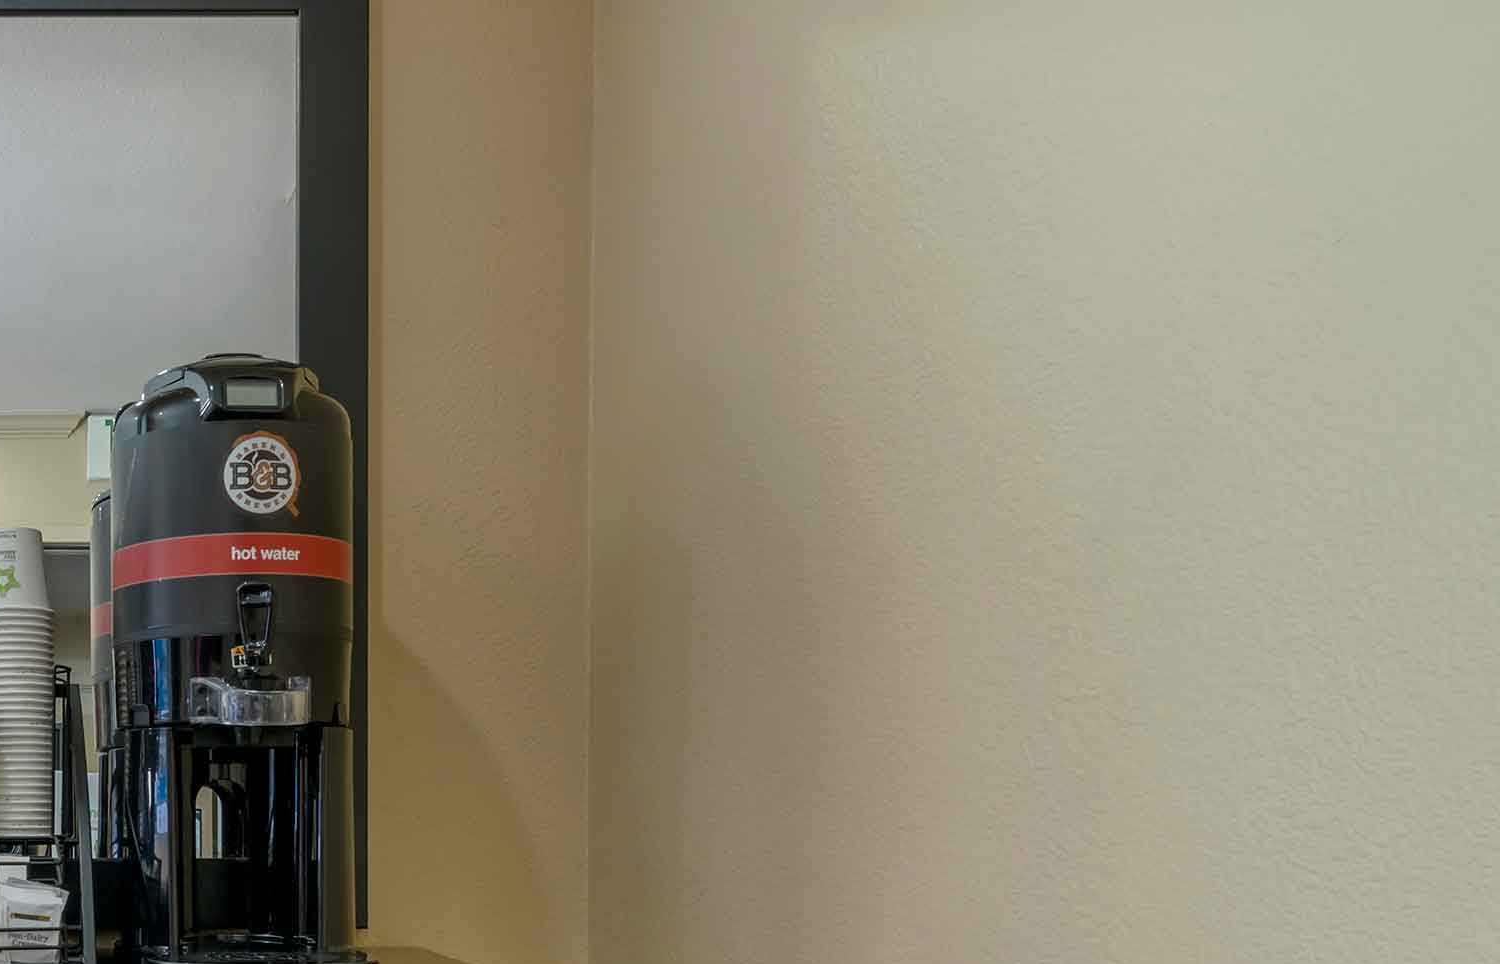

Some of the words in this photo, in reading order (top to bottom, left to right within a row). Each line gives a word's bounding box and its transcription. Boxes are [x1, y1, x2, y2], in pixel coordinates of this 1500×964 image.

[229, 462, 292, 490] B&B
[231, 546, 257, 560] hot
[260, 547, 300, 560] water
